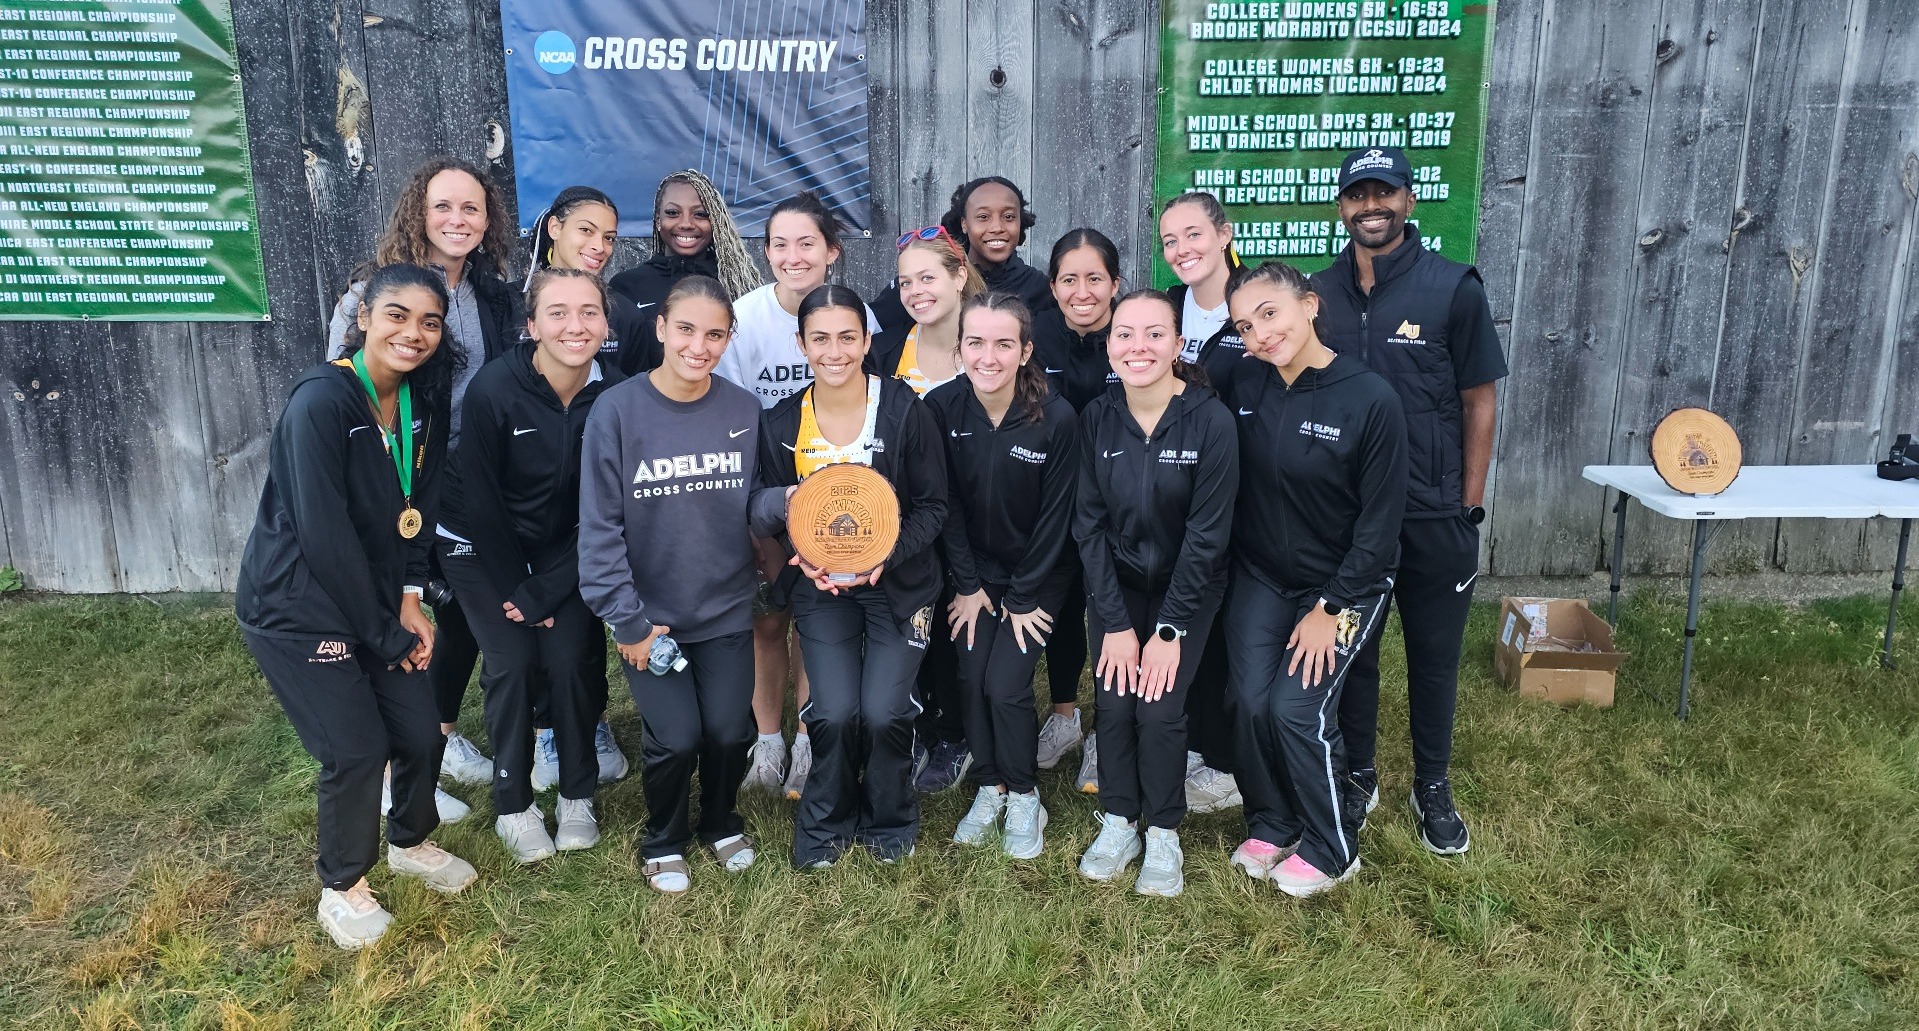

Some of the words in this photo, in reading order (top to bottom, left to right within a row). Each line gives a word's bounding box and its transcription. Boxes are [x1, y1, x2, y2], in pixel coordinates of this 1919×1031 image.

[0, 9, 25, 20] EAST
[29, 10, 86, 21] REGIONAL
[88, 11, 176, 23] CHAMPIONSHIP
[1207, 2, 1280, 20] COLLEGE
[1284, 2, 1358, 19] WOMENS
[1362, 1, 1386, 18] 5K
[1402, 1, 1448, 18] 16:53
[1, 29, 29, 40] EAST
[32, 30, 89, 41] REGIONAL
[91, 31, 178, 43] CHAMPIONSHIP
[1191, 21, 1259, 39] BROOKE
[1264, 20, 1350, 38] MORABITO
[1416, 19, 1461, 36] 2024
[4, 49, 32, 60] EAST
[36, 49, 92, 60] REGIONAL
[94, 50, 181, 62] CHAMPIONSHIP
[539, 51, 576, 64] NCAA
[583, 36, 688, 71] CROSS
[696, 38, 838, 73] COUNTRY
[1205, 59, 1278, 76] COLLEGE
[1282, 58, 1354, 75] WOMENS
[1359, 57, 1382, 74] 6K
[1398, 57, 1444, 74] 19:23
[32, 68, 104, 80] CONFERENCE
[107, 69, 193, 82] CHAMPIONSHIP
[1200, 77, 1253, 95] CHLOE
[1256, 77, 1324, 94] THOMAS
[1402, 75, 1447, 92] 2024
[35, 88, 107, 99] CONFERENCE
[110, 89, 196, 100] CHAMPIONSHIP
[16, 107, 44, 117] EAST
[47, 108, 103, 119] REGIONAL
[105, 108, 190, 119] CHAMPIONSHIP
[1188, 115, 1249, 132] MIDDLE
[1254, 114, 1318, 131] SCHOOL
[1322, 113, 1366, 130] BOYS
[1371, 112, 1393, 129] 3K
[1409, 112, 1455, 129] 10:37
[19, 126, 47, 137] EAST
[50, 126, 107, 137] REGIONAL
[108, 127, 194, 138] CHAMPIONSHIP
[1189, 132, 1221, 150] BEN
[1227, 132, 1295, 149] DANIELS
[1411, 130, 1451, 147] 2019
[10, 144, 60, 156] ALL-NEW
[63, 145, 114, 156] ENGLAND
[117, 146, 202, 157] CHAMPIONSHIP
[46, 164, 118, 175] CONFERENCE
[120, 164, 205, 176] CHAMPIONSHIP
[1349, 156, 1394, 171] ADELPHI
[1195, 169, 1236, 186] HIGH
[1241, 168, 1305, 185] SCHOOL
[1309, 167, 1341, 184] BOY
[1412, 166, 1441, 183] :02
[7, 182, 71, 193] NORTHEAST
[74, 183, 130, 194] REGIONAL
[132, 183, 217, 194] CHAMPIONSHIP
[1225, 187, 1296, 204] REPUCCI
[1411, 183, 1450, 200] 2015
[0, 201, 17, 211] AA
[20, 201, 68, 211] ALL-NEW
[71, 201, 121, 212] ENGLAND
[124, 202, 209, 213] CHAMPIONSHIP
[31, 219, 73, 230] MIDDLE
[75, 220, 118, 231] SCHOOL
[120, 220, 155, 231] STATE
[157, 221, 250, 231] CHAMPIONSHIPS
[1233, 222, 1281, 238] LLEGE
[1286, 221, 1330, 237] MENS
[25, 238, 54, 248] EAST
[57, 238, 128, 249] CONFERENCE
[130, 239, 214, 249] CHAMPIONSHIP
[1420, 236, 1442, 252] 24
[17, 256, 33, 266] DII
[36, 256, 65, 267] EAST
[68, 256, 123, 267] REGIONAL
[125, 257, 207, 267] CHAMPIONSHIP
[5, 274, 17, 284] DI
[20, 274, 84, 285] NORTHEAST
[87, 275, 141, 285] REGIONAL
[143, 275, 226, 285] CHAMPIONSHIP
[22, 292, 42, 302] DIII
[45, 292, 73, 303] EAST
[75, 292, 130, 303] REGIONAL
[132, 292, 215, 303] CHAMPIONSHIP
[1395, 319, 1421, 340] AU
[1220, 335, 1244, 344] ADELP
[757, 363, 815, 383] ADEL
[755, 386, 794, 397] CROSS
[1010, 444, 1047, 460] ADELPHI
[633, 451, 742, 484] ADELPHI
[633, 484, 680, 499] CROSS
[685, 478, 744, 492] COUNTRY
[830, 485, 859, 497] 2025
[814, 498, 873, 529] HOPKINTON
